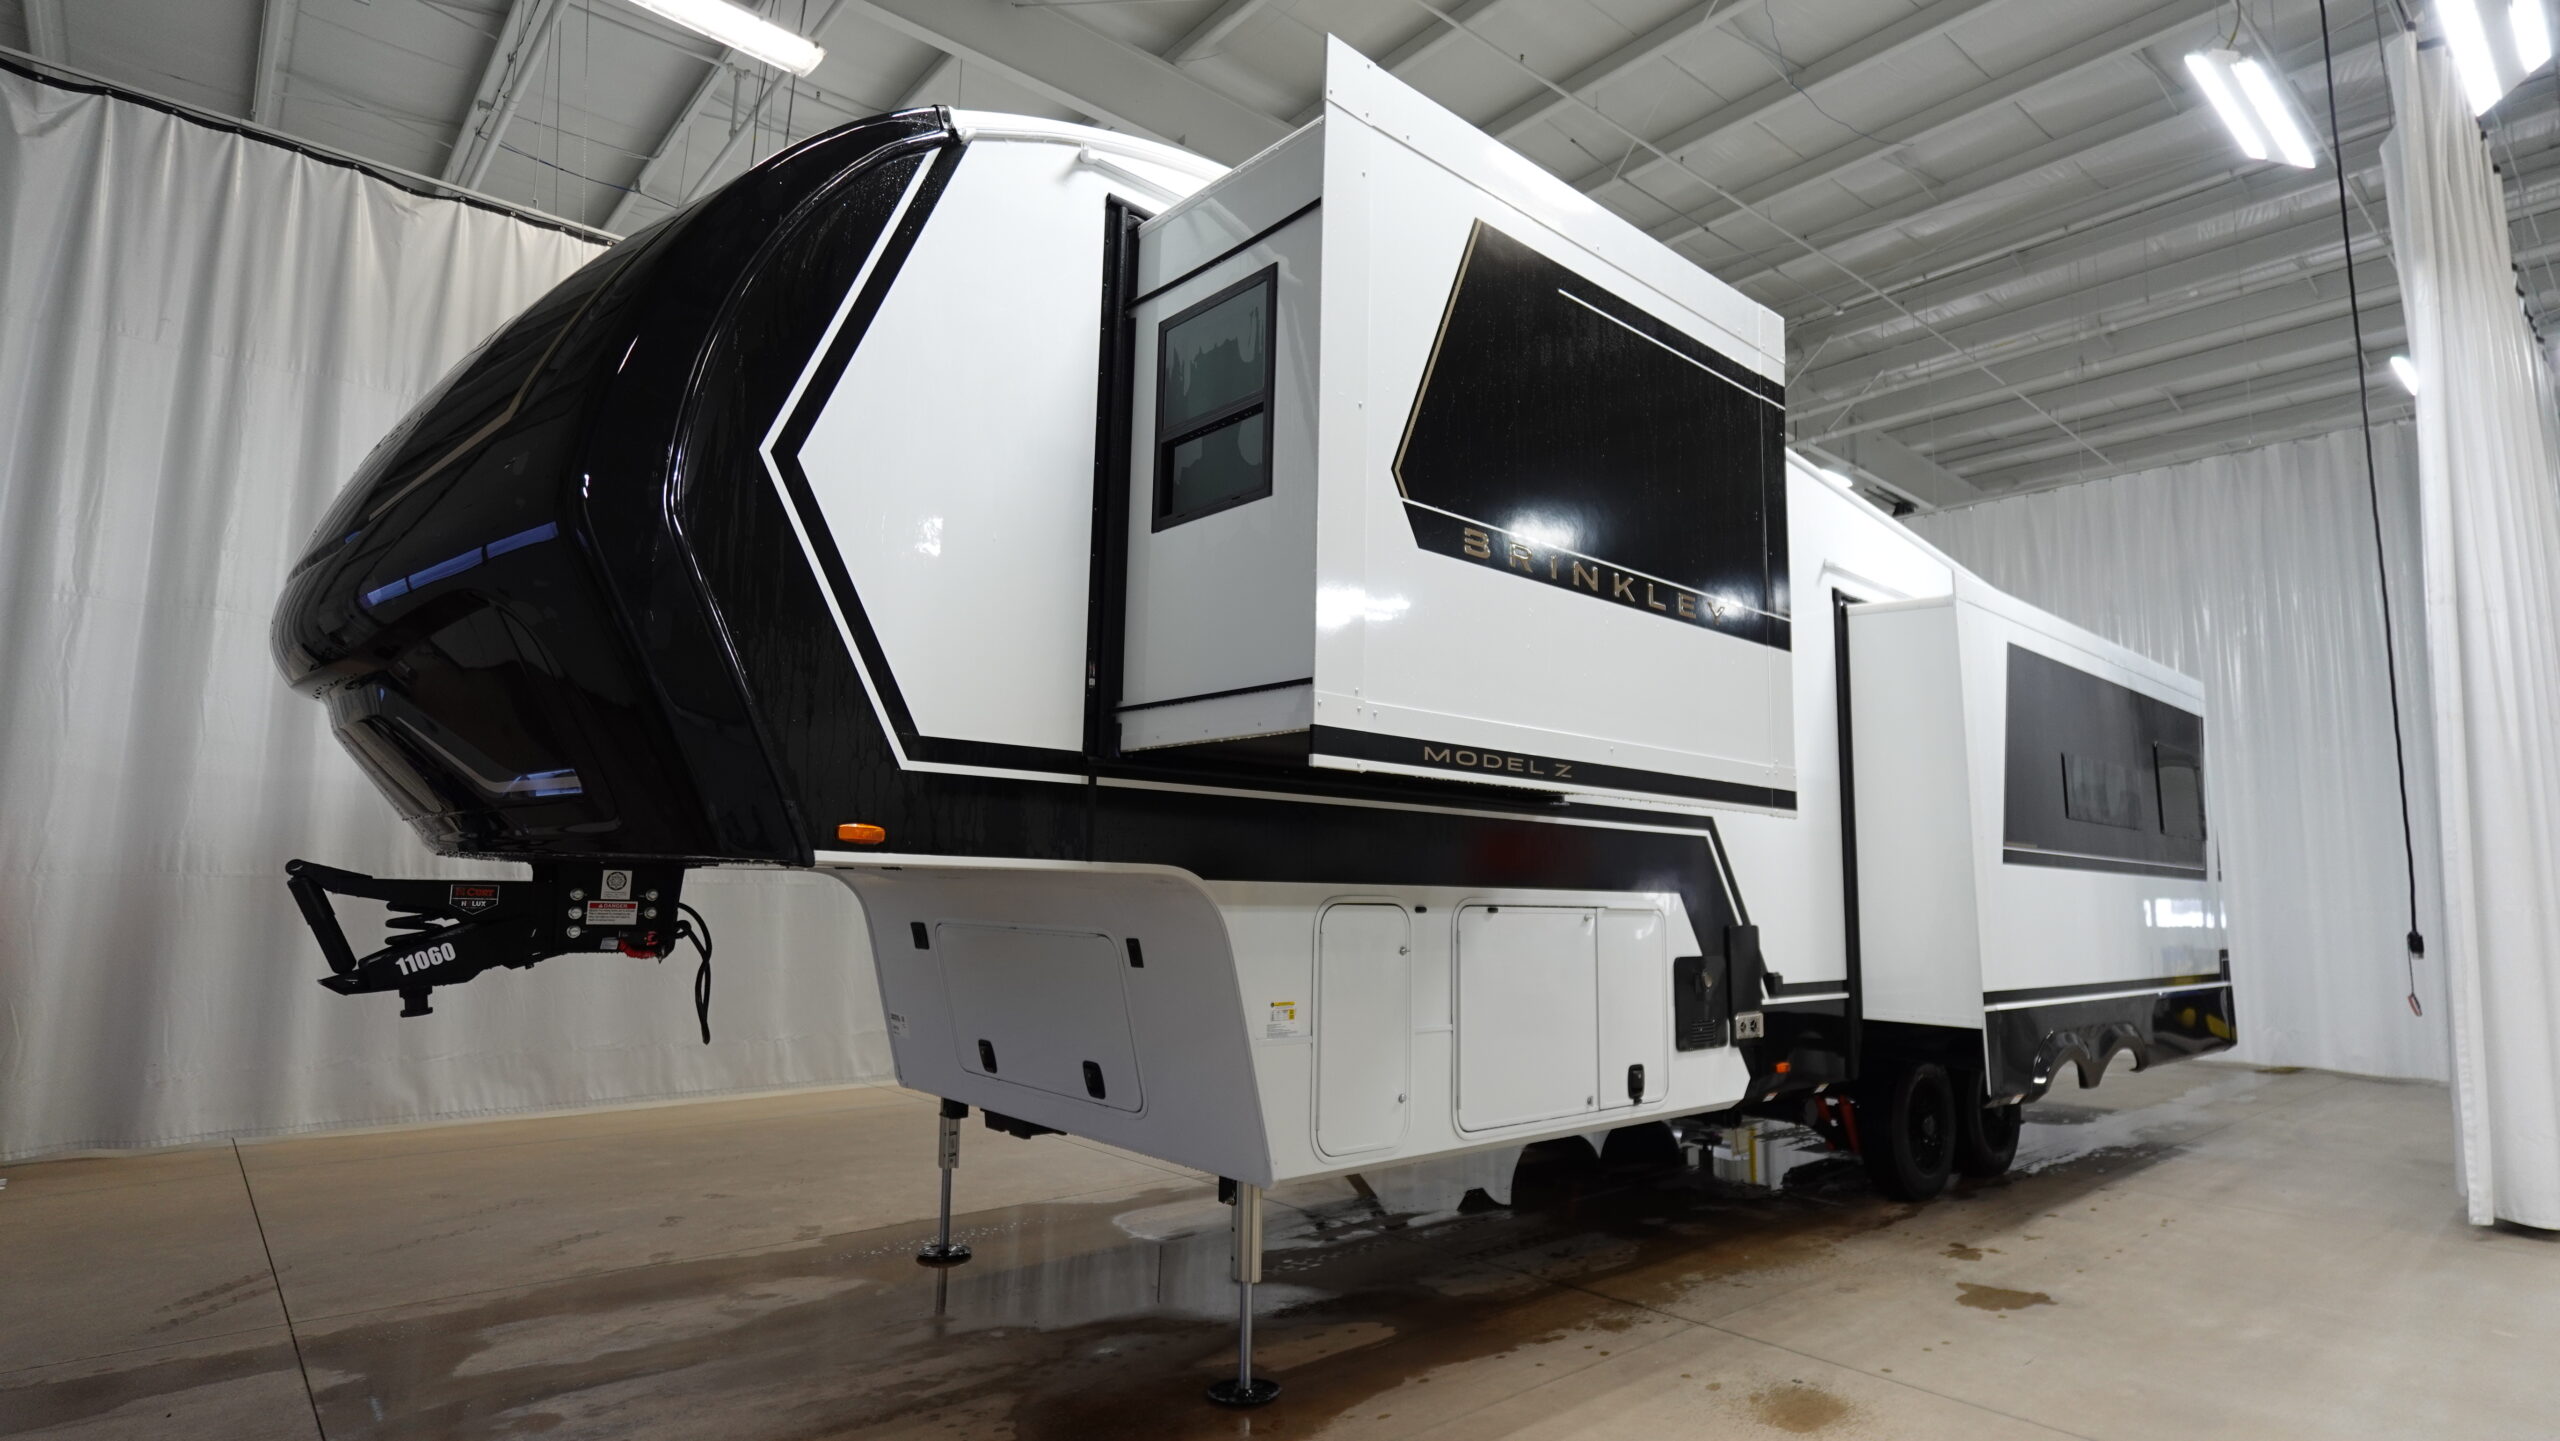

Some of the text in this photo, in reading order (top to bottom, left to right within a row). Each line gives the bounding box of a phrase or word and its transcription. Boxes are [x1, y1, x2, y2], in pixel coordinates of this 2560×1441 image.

[1463, 527, 1726, 626] BRINKLEY
[1423, 746, 1573, 778] MODEL Z
[394, 942, 456, 976] 11060
